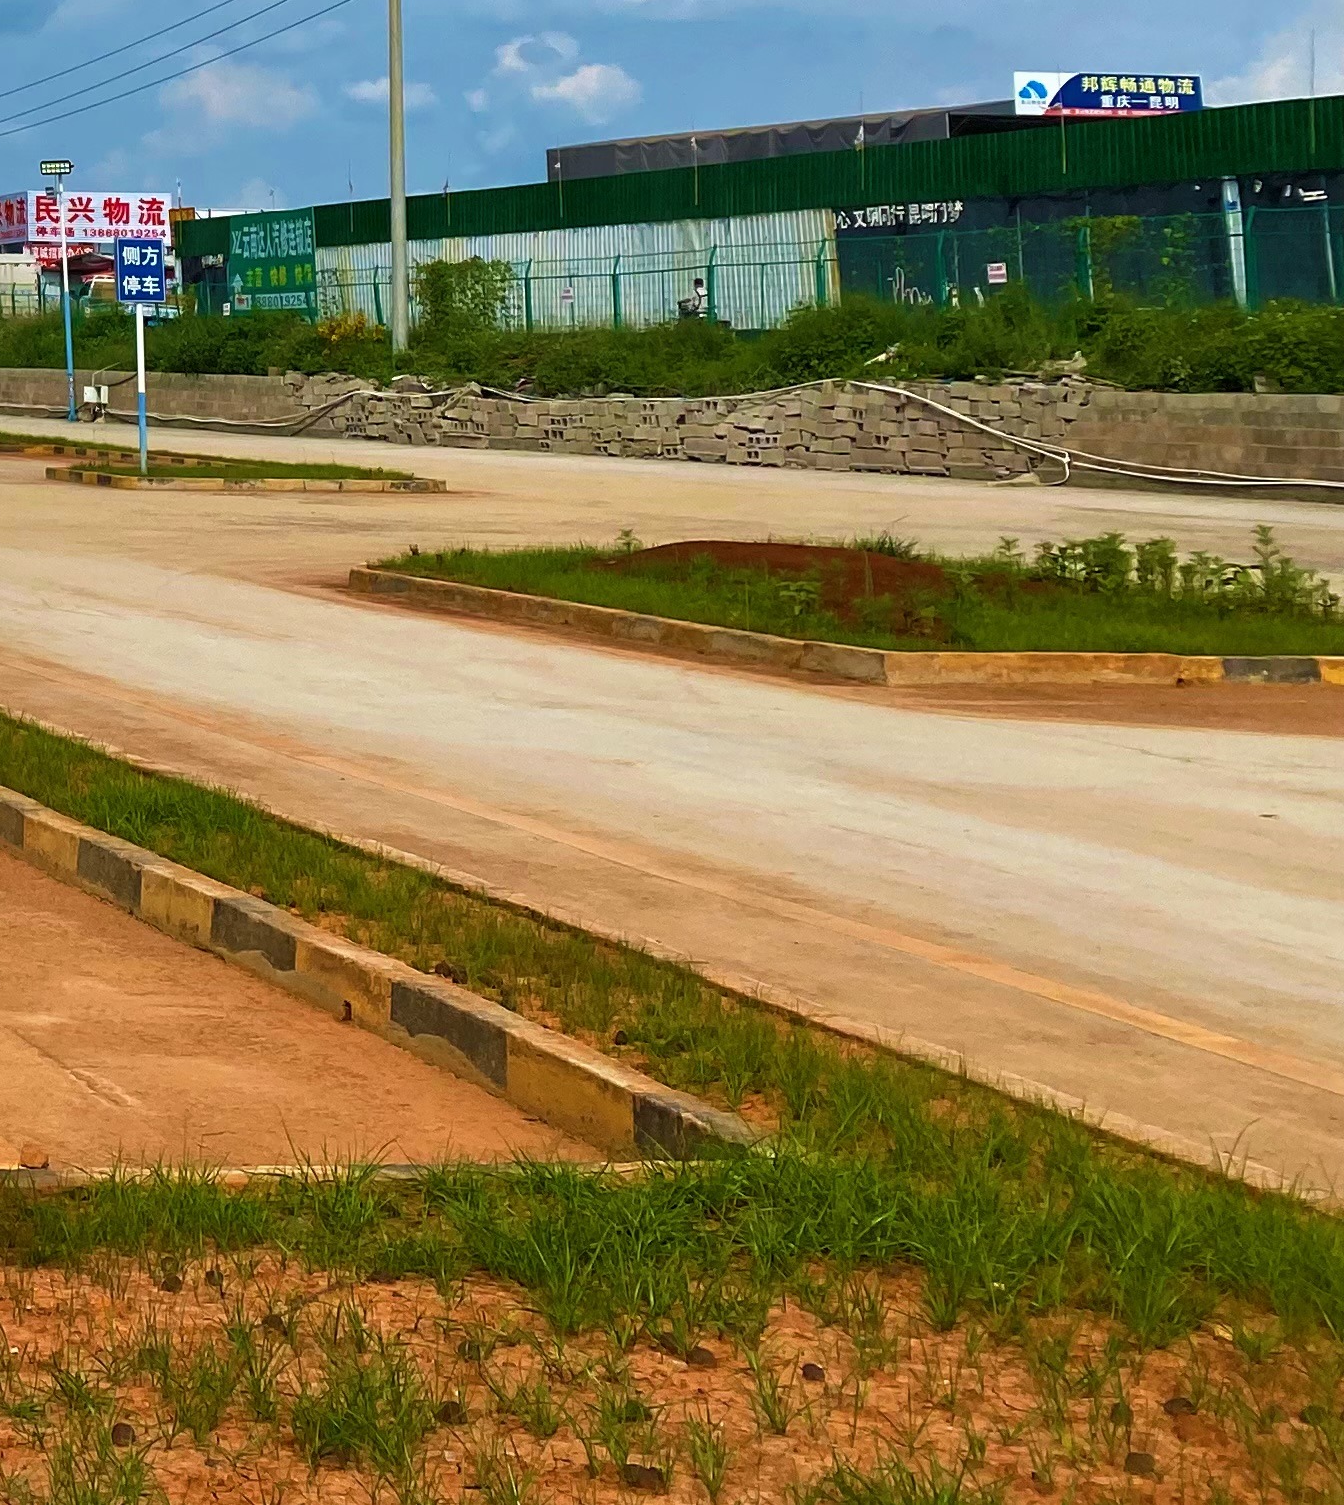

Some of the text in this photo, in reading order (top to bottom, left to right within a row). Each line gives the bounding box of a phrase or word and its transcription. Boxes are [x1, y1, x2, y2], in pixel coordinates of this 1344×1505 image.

[1081, 75, 1196, 95] 邦辉畅通物流
[35, 195, 166, 226] 民兴物流
[122, 245, 159, 266] 侧方
[122, 275, 160, 296] 停车
